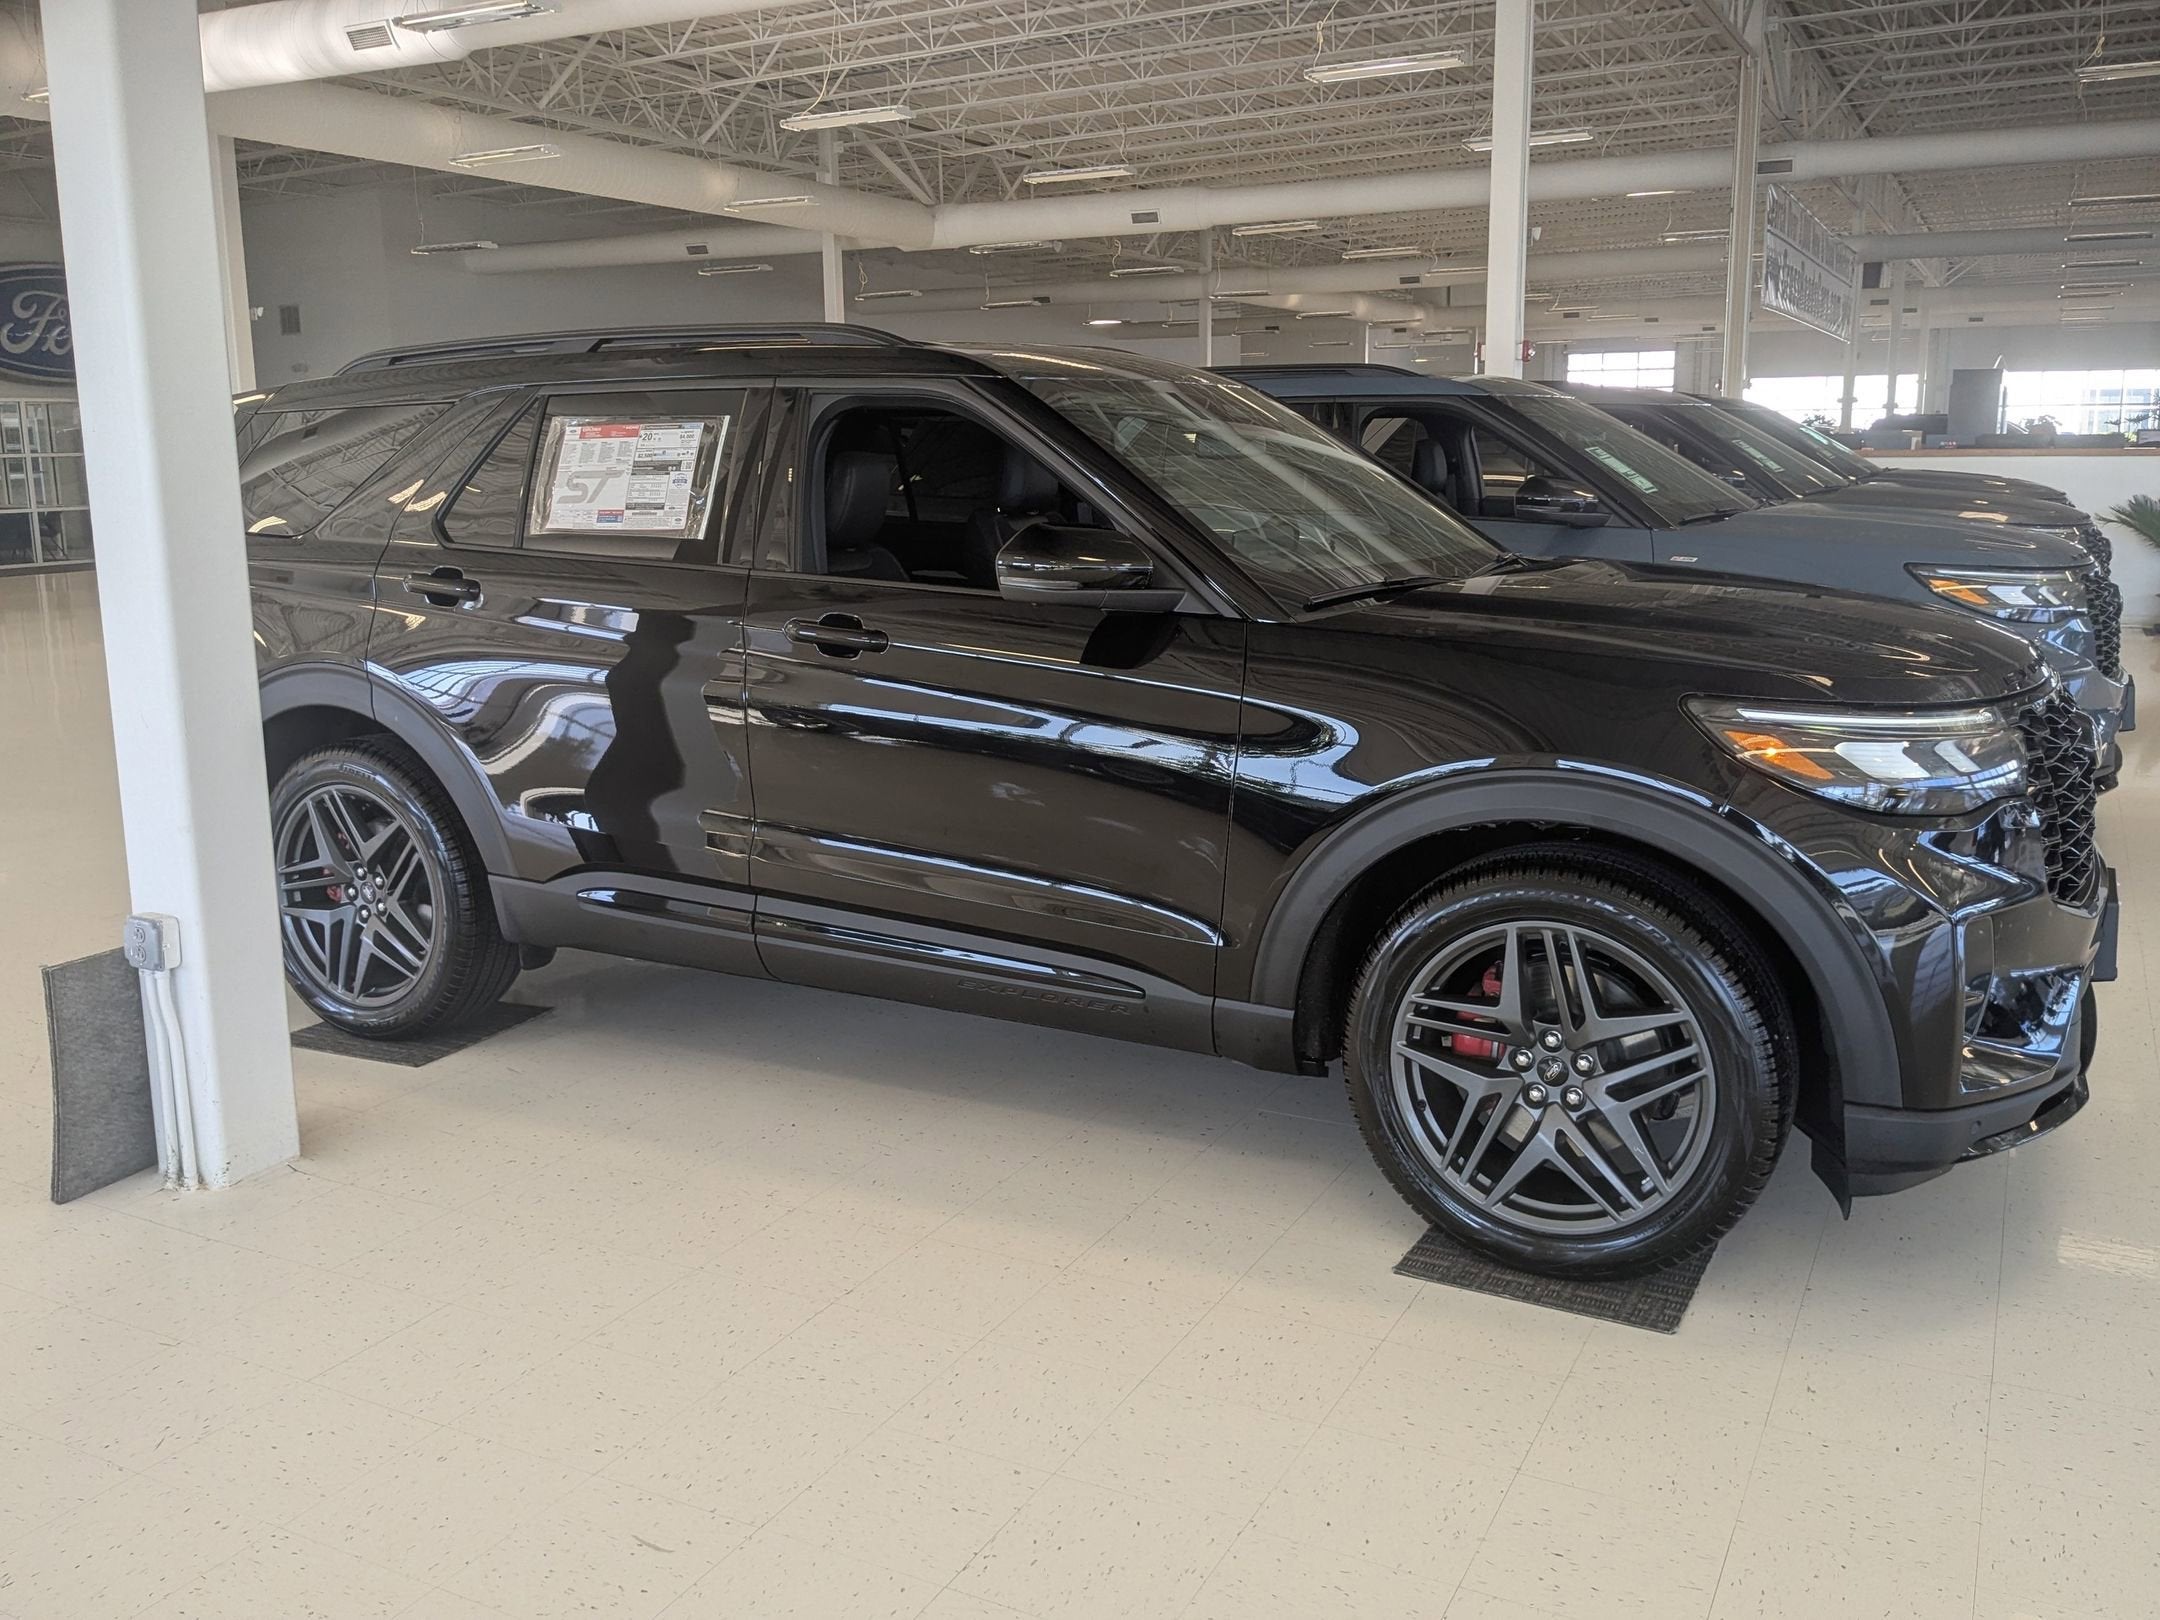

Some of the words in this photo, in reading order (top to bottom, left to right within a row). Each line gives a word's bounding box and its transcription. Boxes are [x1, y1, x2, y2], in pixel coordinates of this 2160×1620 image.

[0, 290, 74, 355] Fo
[556, 470, 625, 504] ST
[956, 978, 1132, 1016] EXPLORER
